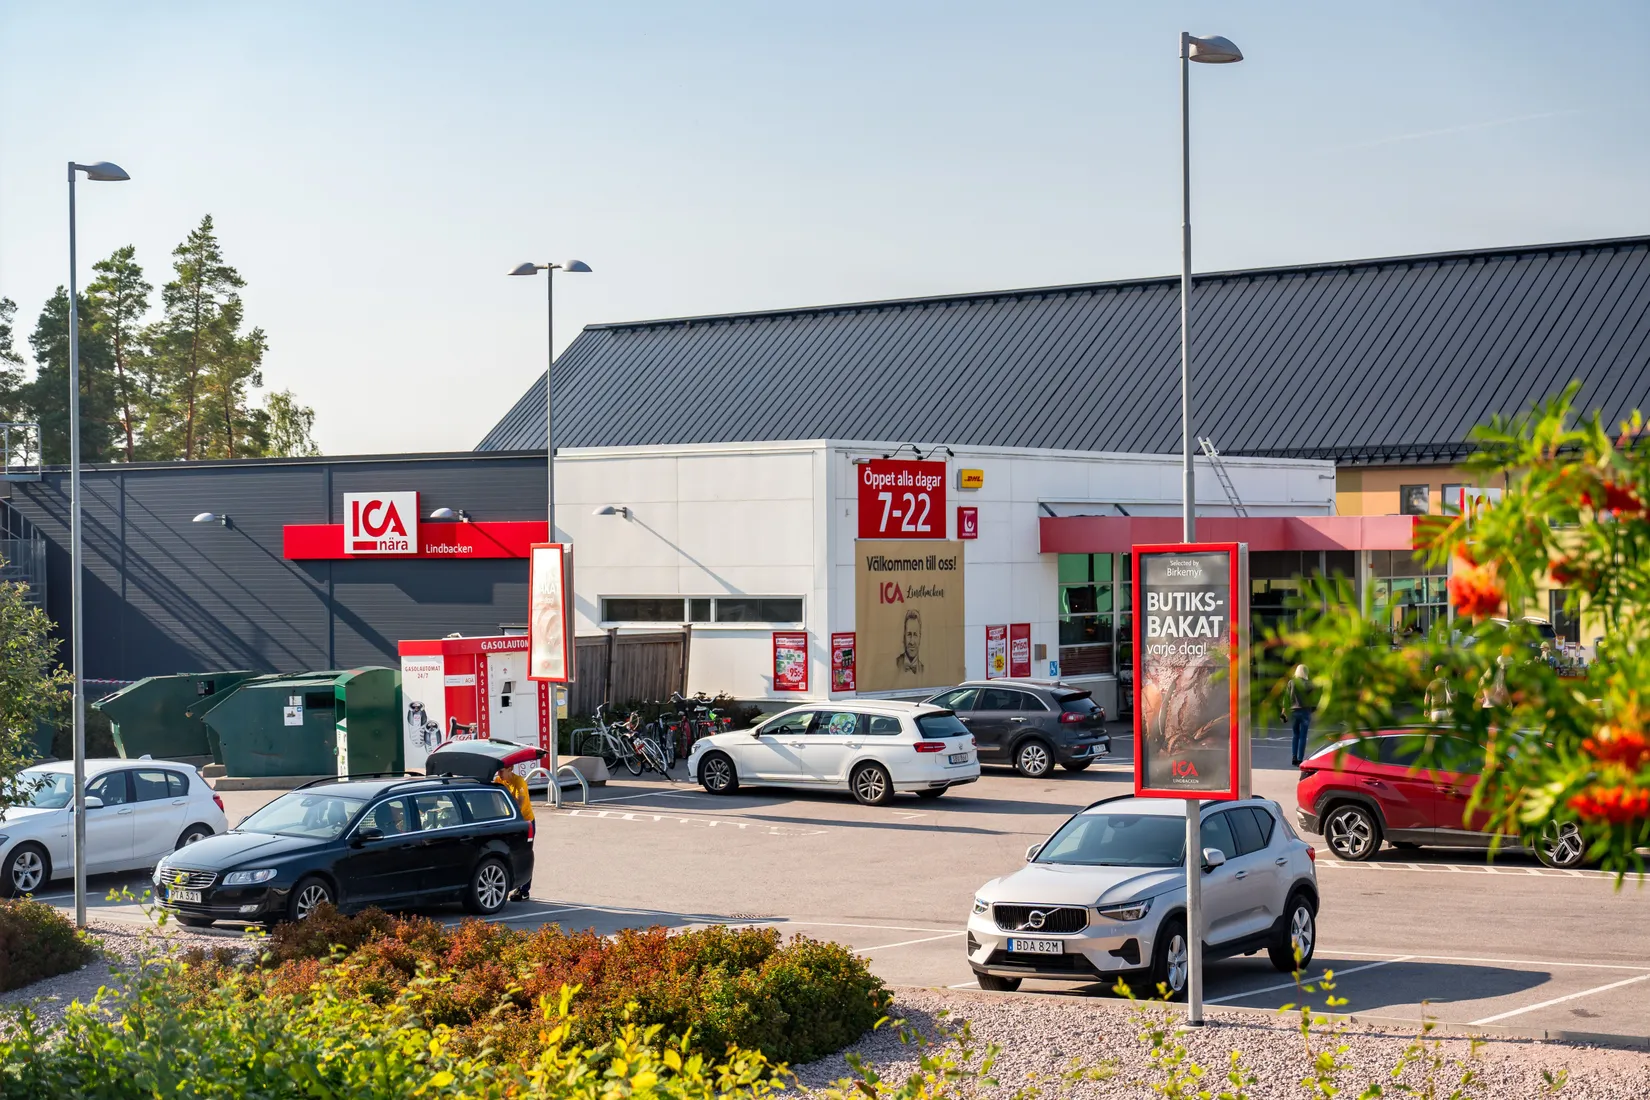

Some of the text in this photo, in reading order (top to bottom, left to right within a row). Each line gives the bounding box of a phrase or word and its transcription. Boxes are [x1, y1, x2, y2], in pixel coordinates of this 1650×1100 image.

[863, 467, 942, 491] Öppet alla dagar
[352, 500, 408, 537] ICA
[877, 491, 931, 533] 7-22
[379, 536, 409, 551] nära
[425, 543, 473, 554] Lindbacken
[866, 554, 957, 571] Välkommen till oss!
[1170, 559, 1200, 568] Selected by
[1166, 567, 1203, 578] Birkemyr
[879, 581, 905, 604] ICA
[1147, 591, 1224, 612] BUTIKS-
[1147, 615, 1224, 638] BAKAT
[1146, 641, 1207, 658] varje dag!
[404, 664, 441, 672] GASOLAUTOMAT
[1172, 759, 1199, 777] ICA
[185, 891, 199, 902] 321
[1016, 940, 1059, 953] BDA 82M
